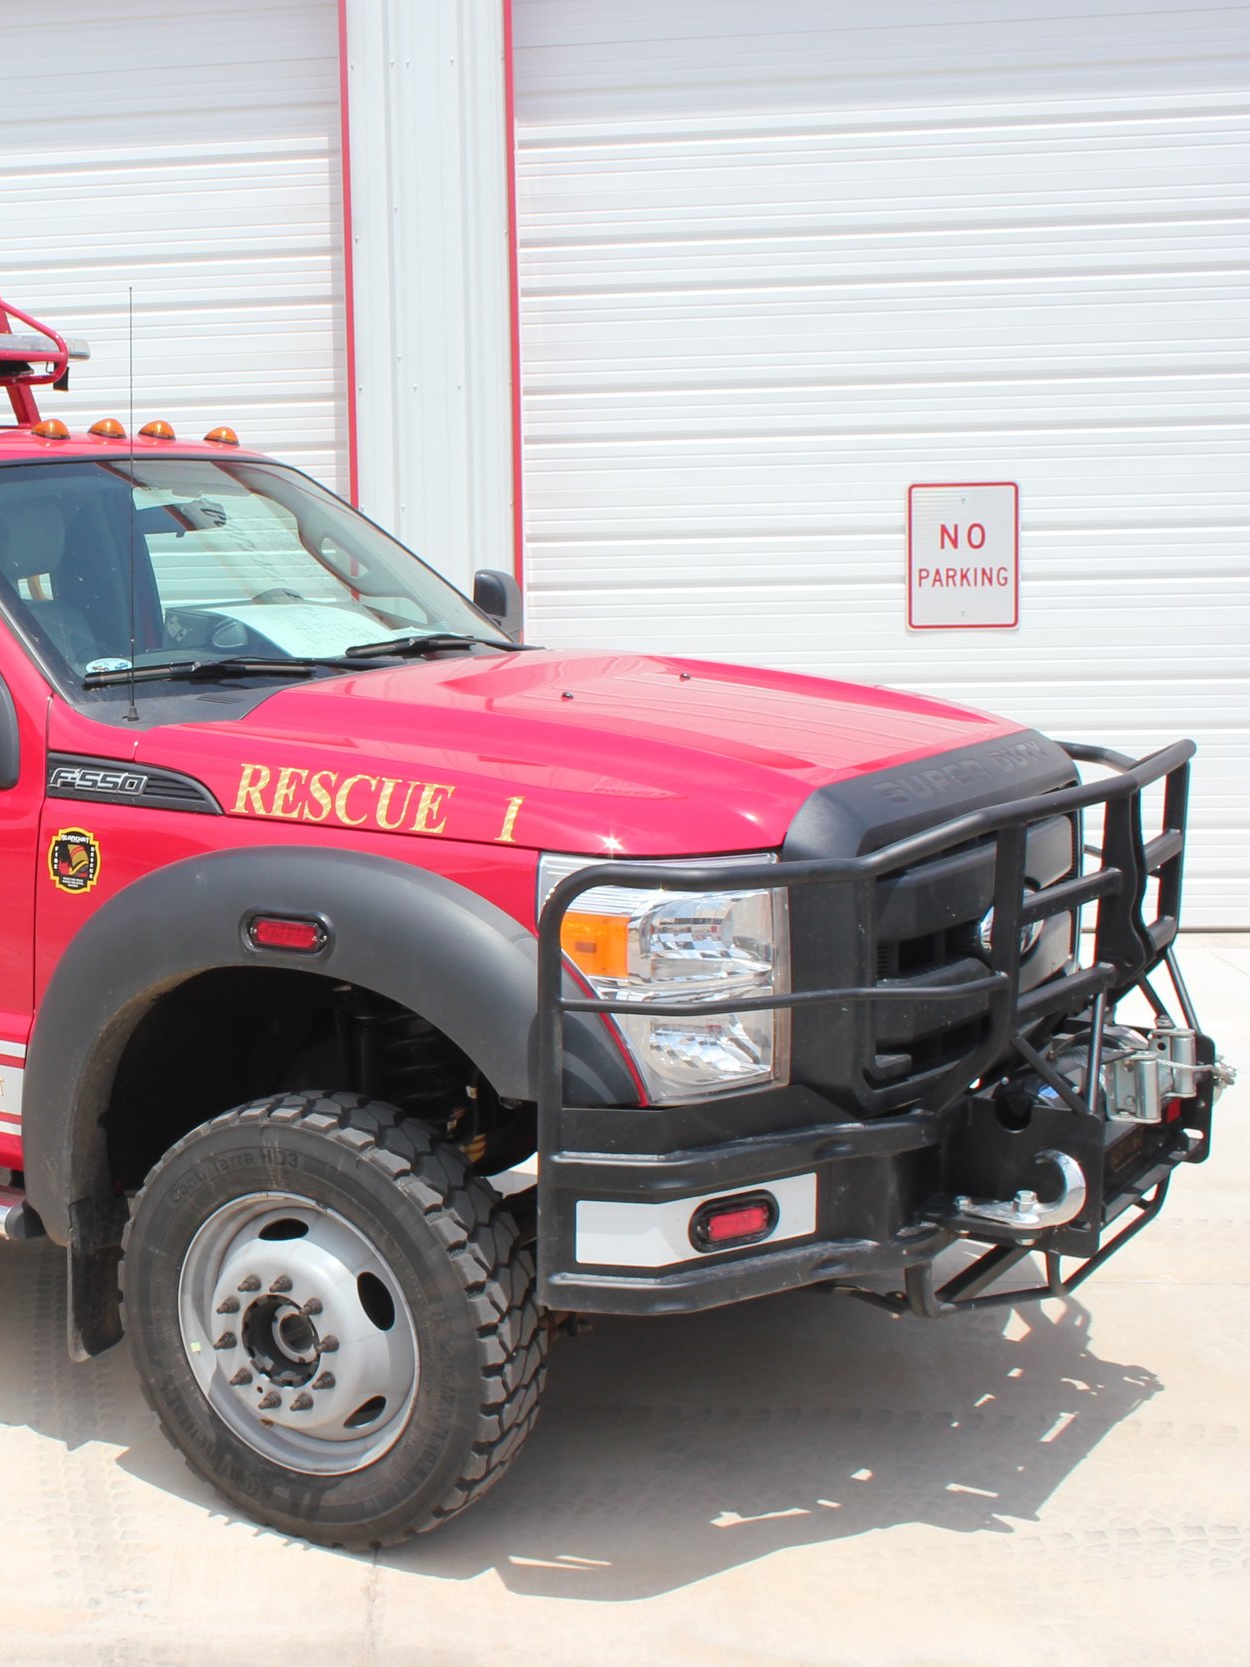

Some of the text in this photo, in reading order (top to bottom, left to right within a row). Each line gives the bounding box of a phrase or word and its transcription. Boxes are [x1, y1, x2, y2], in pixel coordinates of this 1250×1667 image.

[939, 522, 986, 550] NO
[918, 566, 1009, 588] PARKING
[873, 739, 1048, 806] SUPER DUTY
[230, 763, 525, 843] RESCUE 1
